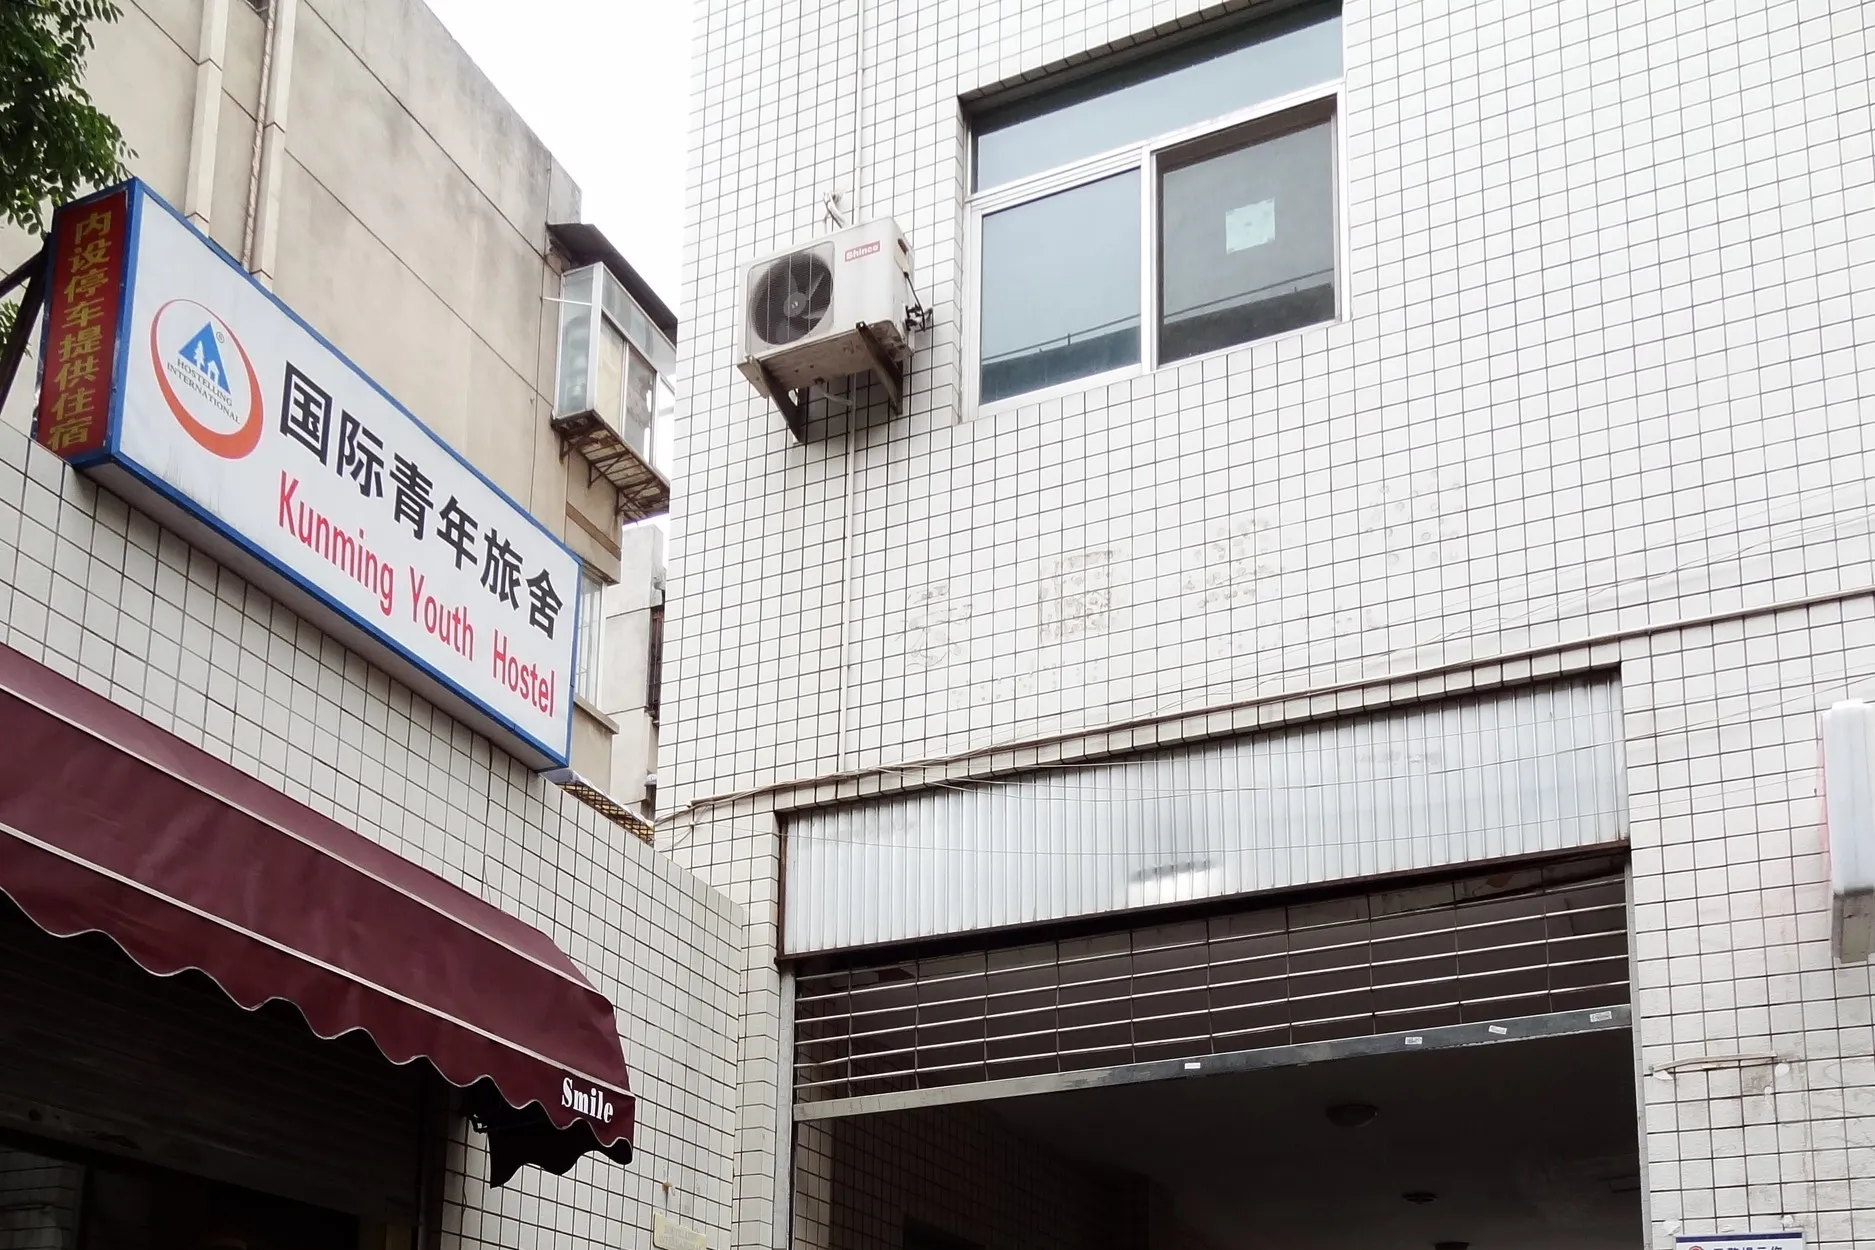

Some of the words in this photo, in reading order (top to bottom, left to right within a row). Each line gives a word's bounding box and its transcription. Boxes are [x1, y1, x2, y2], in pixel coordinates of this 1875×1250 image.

[846, 245, 879, 260] Shinco
[47, 210, 112, 450] 内设停车提供住宿
[167, 362, 241, 425] INTERNATIONAL
[176, 358, 232, 407] HOSTELLING
[280, 360, 564, 640] 国际青年旅舍
[279, 469, 394, 616] Kunming
[409, 565, 475, 662] Youth
[492, 629, 555, 718] Hostel
[561, 1077, 614, 1123] Smile
